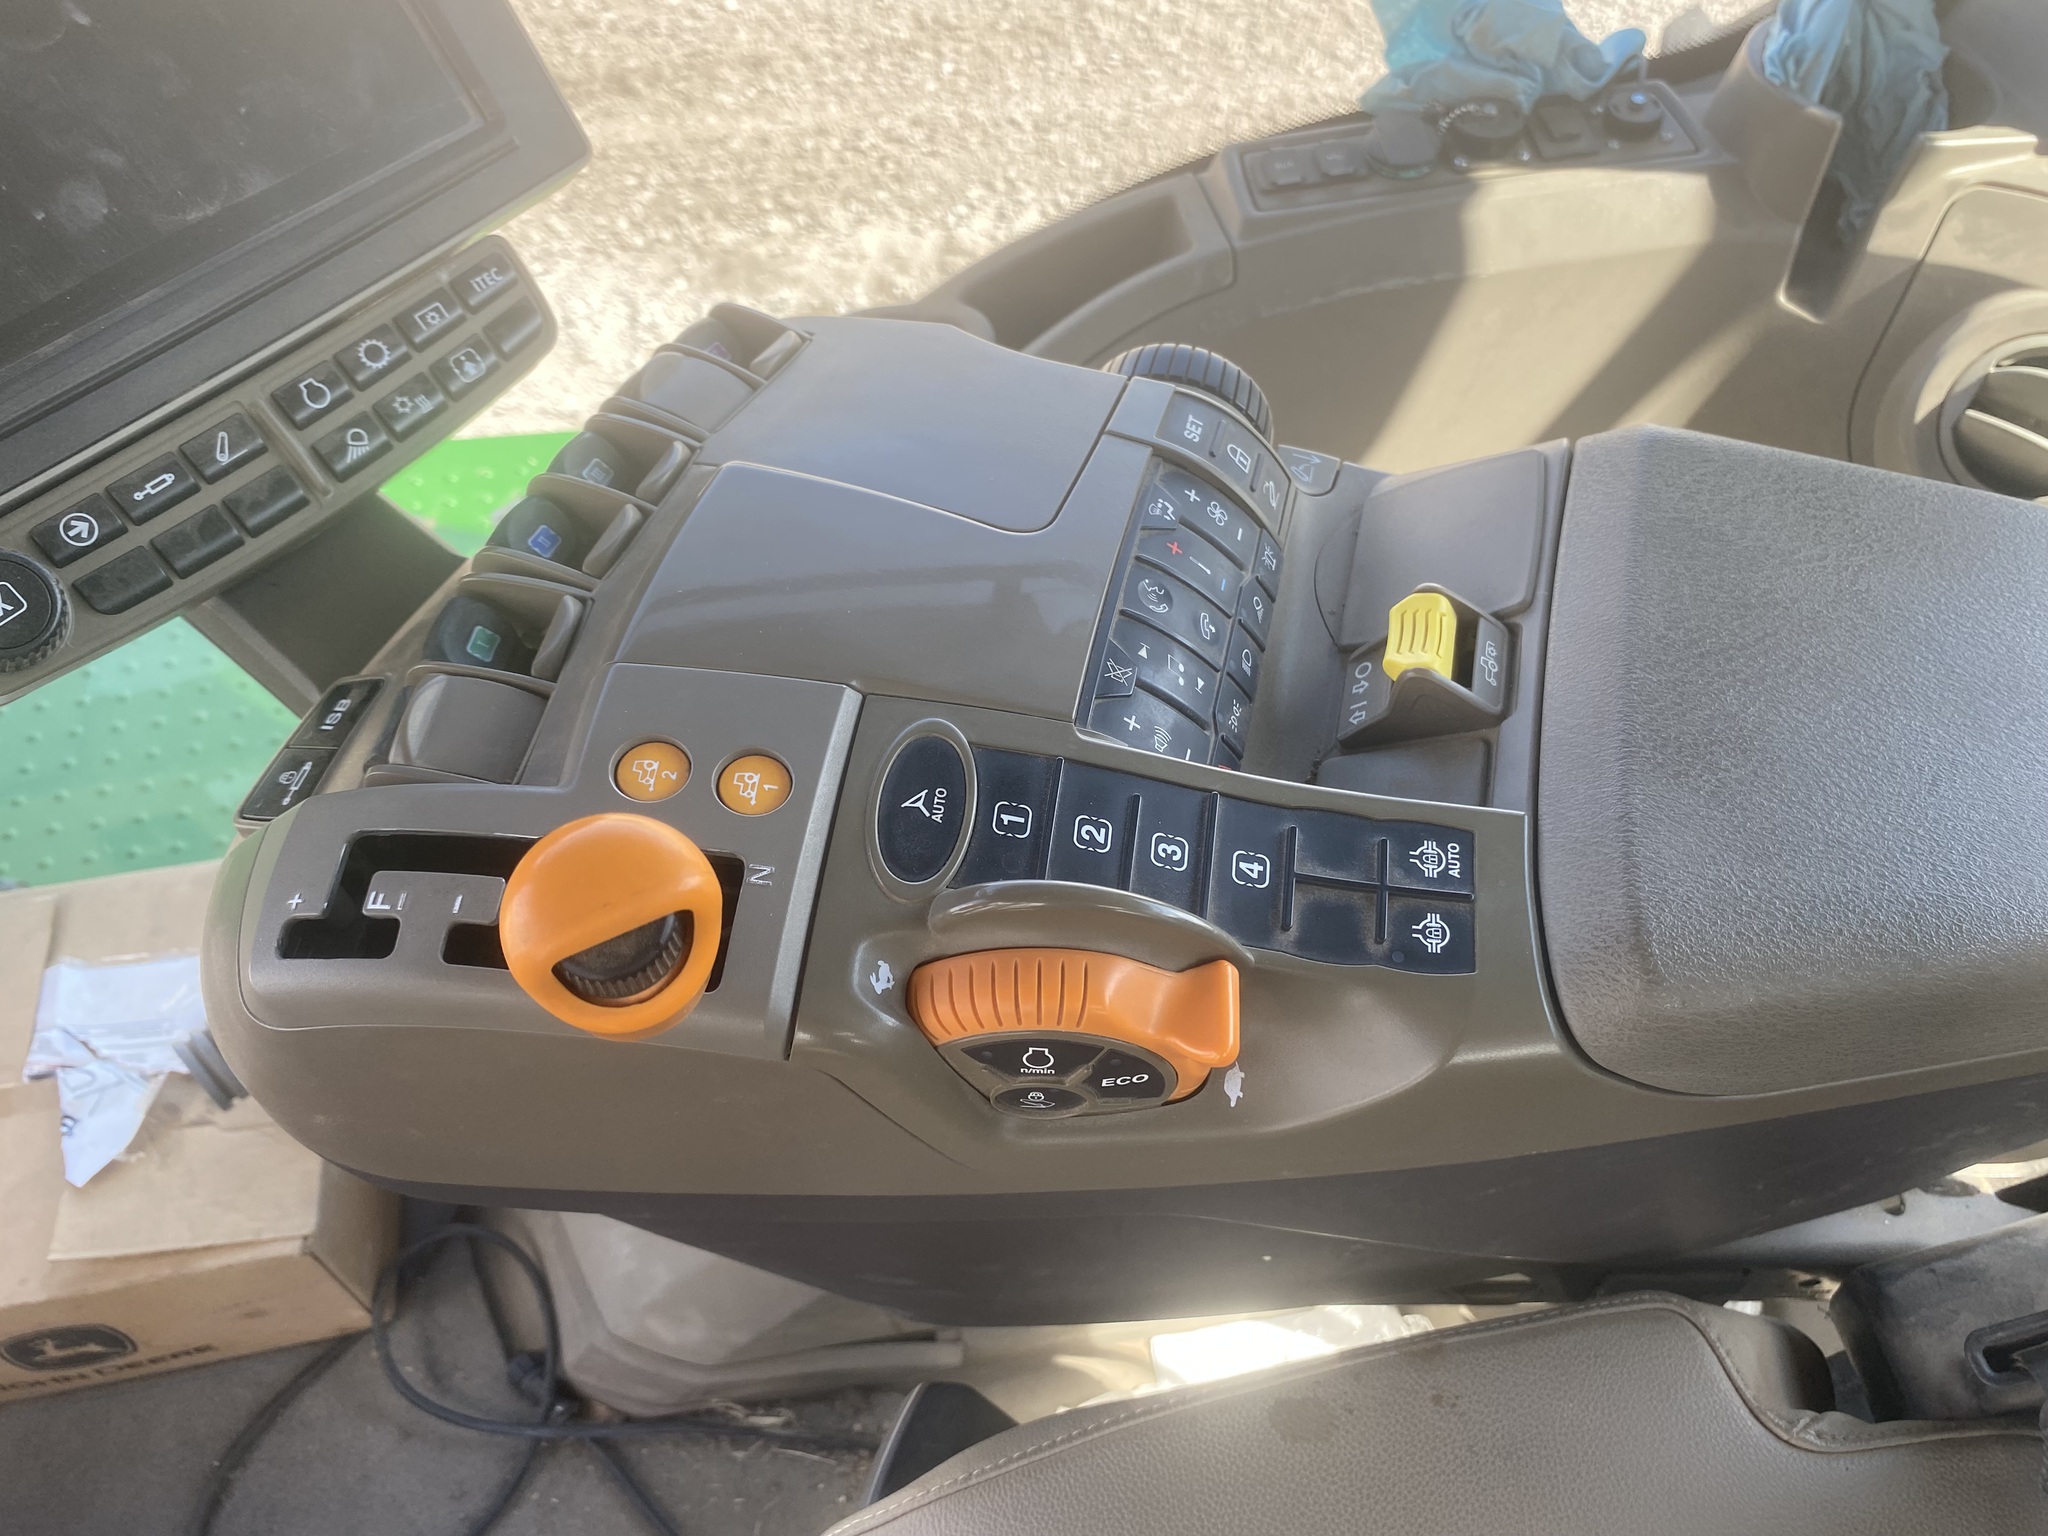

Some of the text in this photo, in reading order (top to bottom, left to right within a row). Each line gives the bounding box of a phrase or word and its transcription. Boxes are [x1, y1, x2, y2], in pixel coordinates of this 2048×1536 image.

[1183, 414, 1204, 443] SET
[319, 698, 352, 731] ISB
[661, 770, 678, 781] 2
[763, 783, 779, 791] 1
[931, 787, 948, 824] AUTO
[999, 812, 1026, 826] 1
[1080, 826, 1106, 844] 2
[1157, 842, 1182, 861] 3
[1448, 842, 1461, 878] AUTO
[746, 863, 775, 887] N
[1239, 859, 1264, 879] 4
[366, 889, 392, 911] F
[1020, 1067, 1056, 1075] n/min
[1101, 1073, 1150, 1088] ECO
